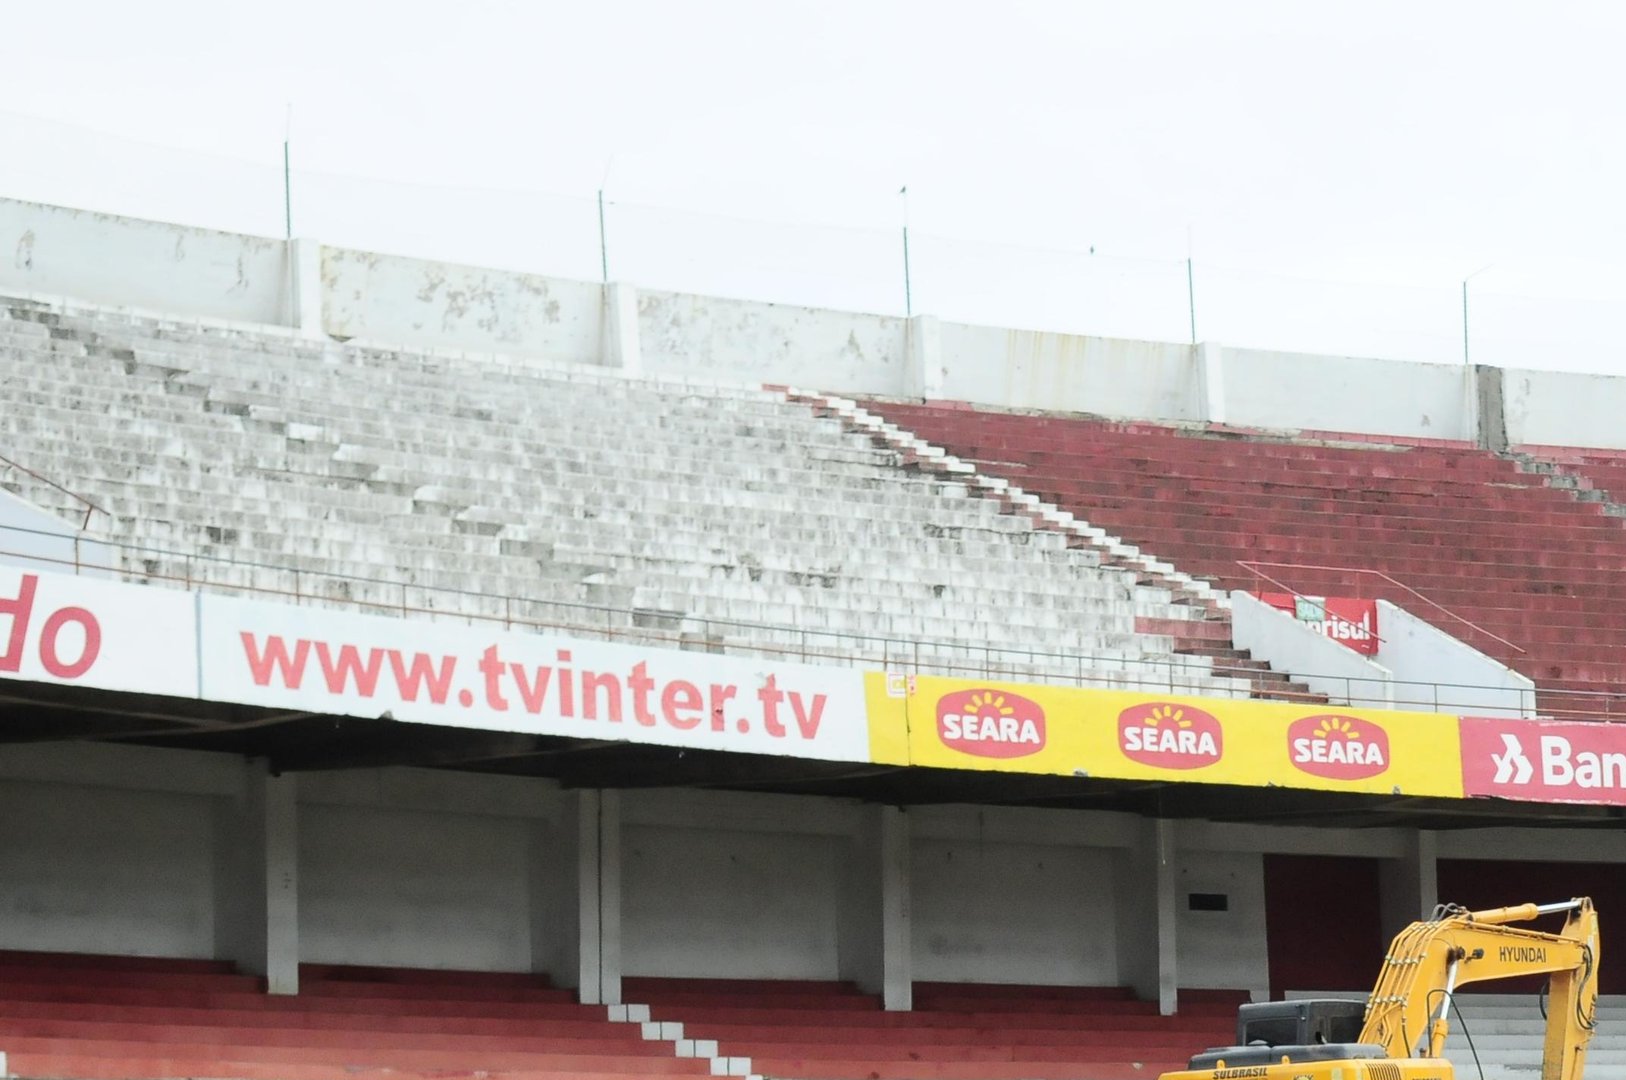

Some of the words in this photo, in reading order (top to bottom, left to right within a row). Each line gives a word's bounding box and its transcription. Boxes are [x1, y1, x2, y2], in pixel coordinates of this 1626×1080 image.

[241, 631, 828, 741] www.tvinter.tv
[942, 713, 1041, 745] SEARA
[1123, 726, 1218, 757] SEARA
[1293, 737, 1384, 767] SEARA
[1499, 946, 1547, 963] HYUNDAI
[1212, 1067, 1268, 1080] SULBRASIL
